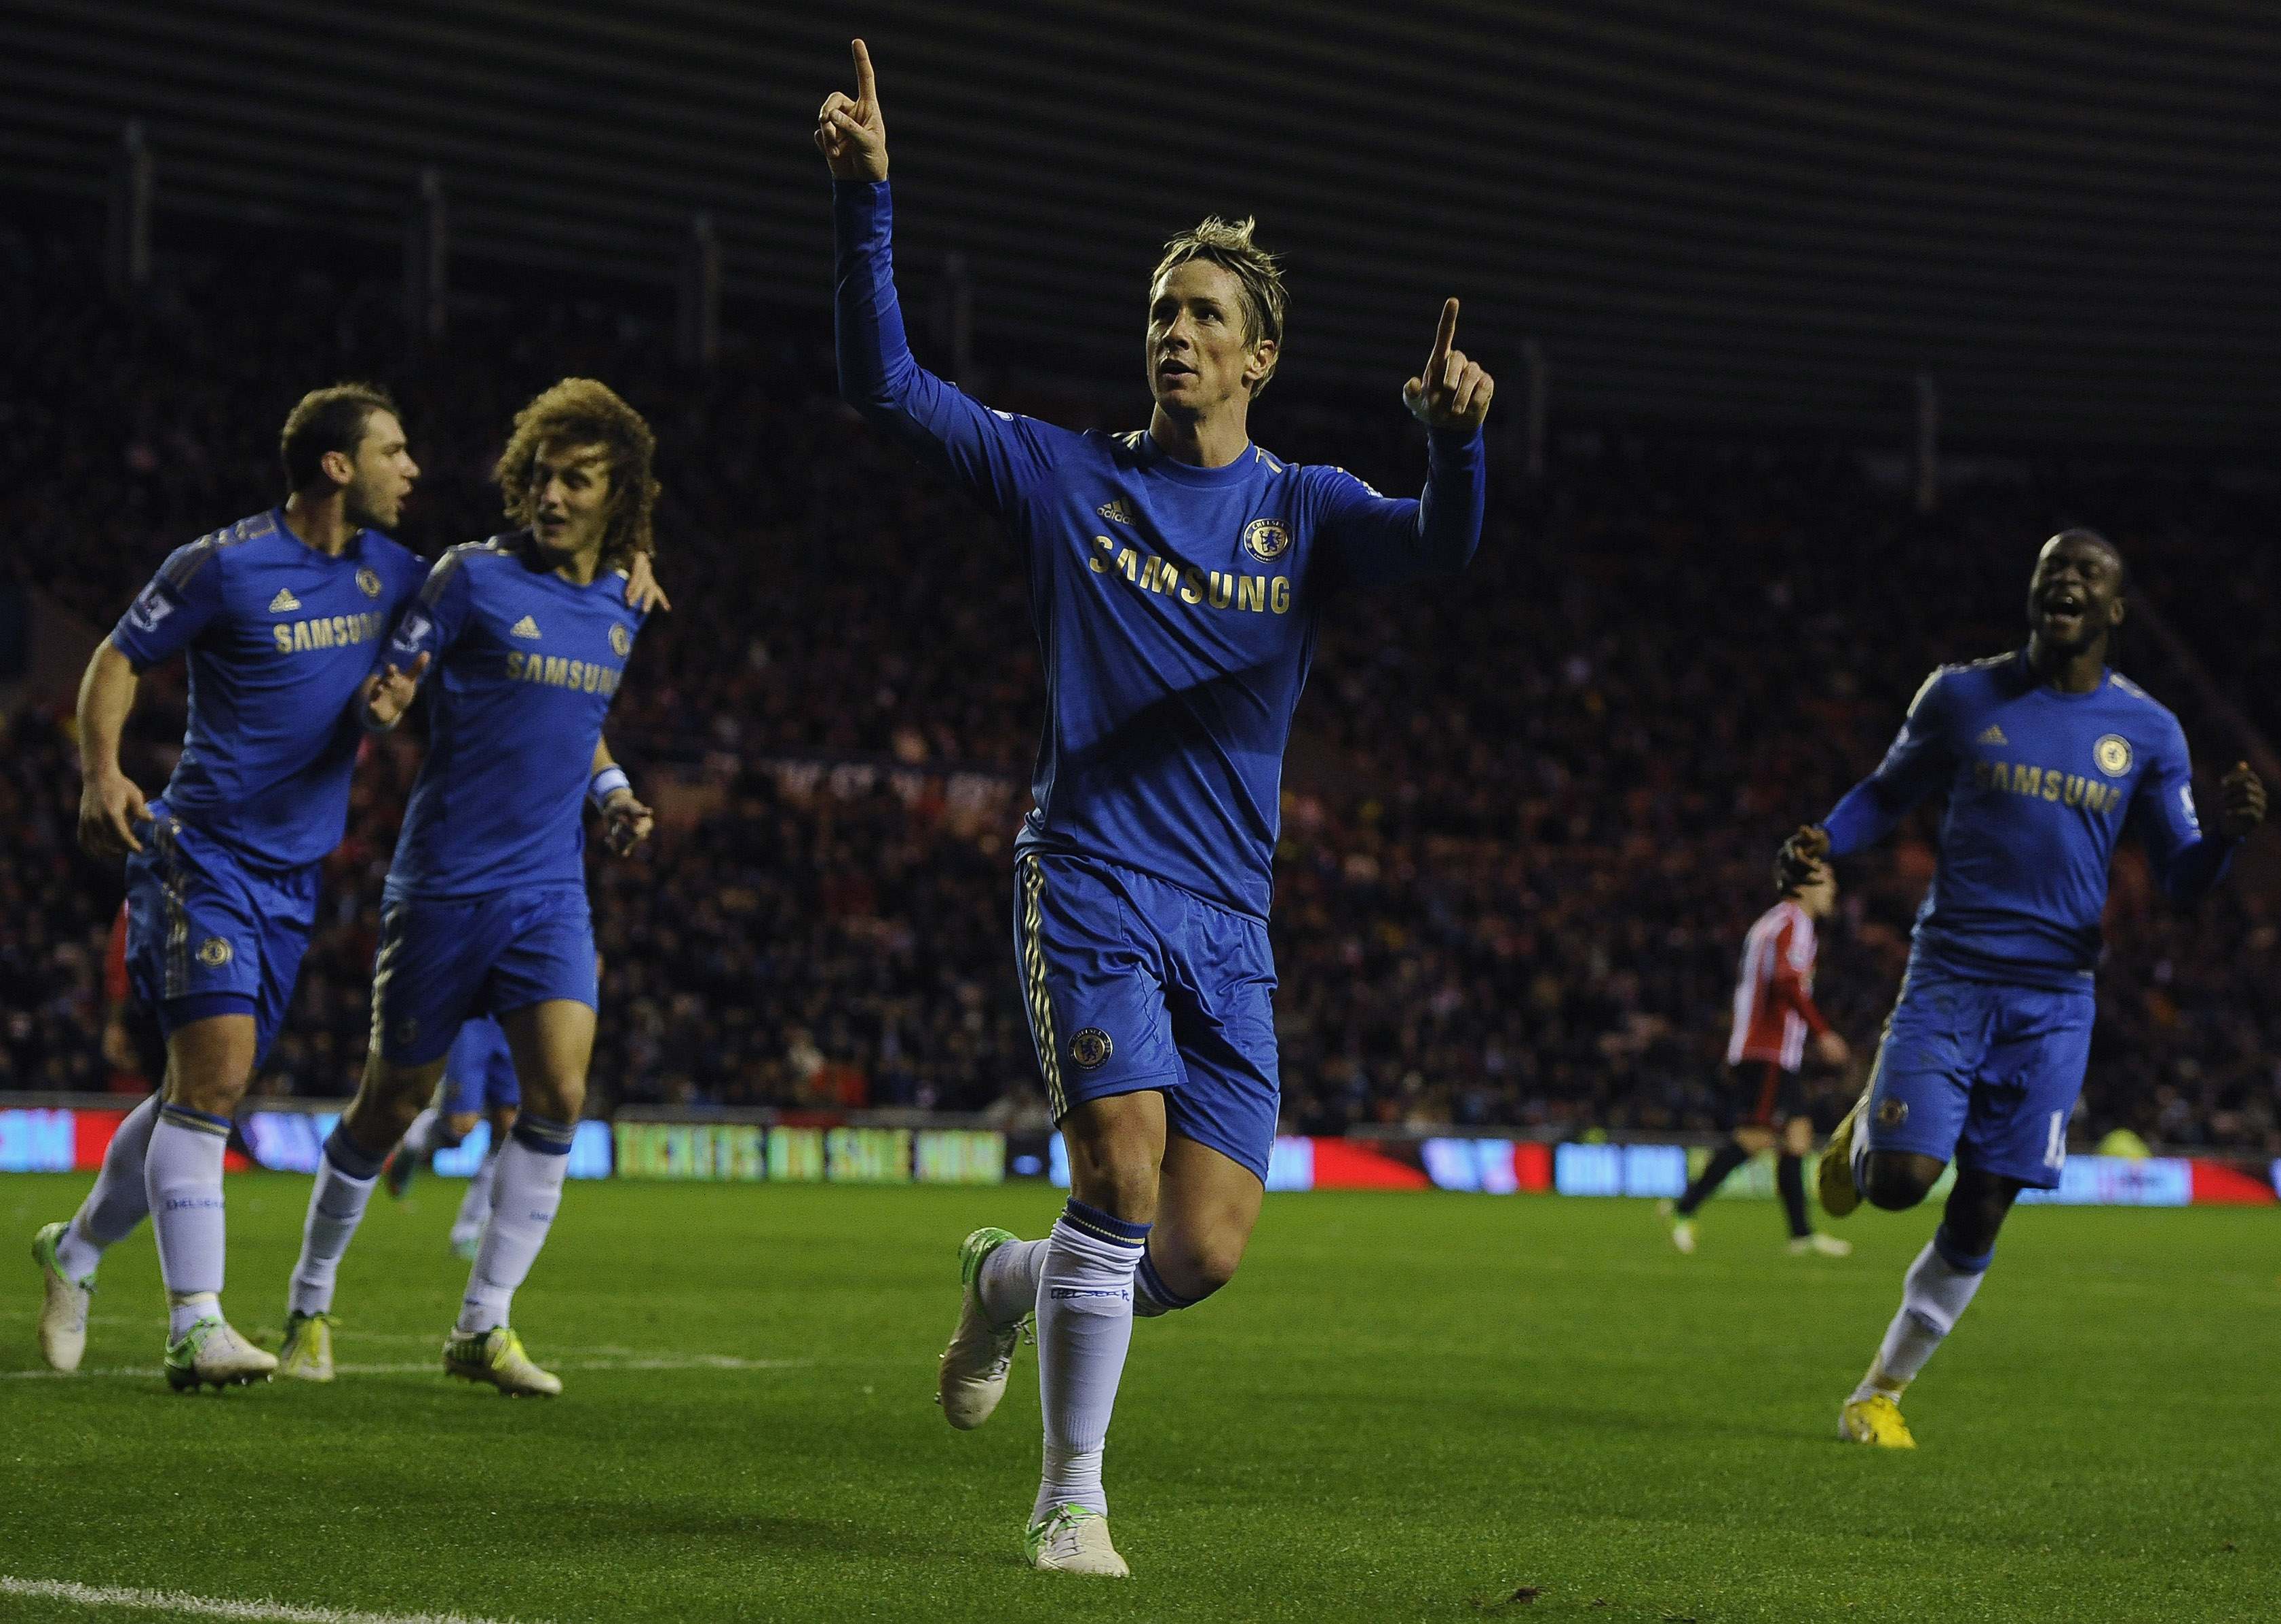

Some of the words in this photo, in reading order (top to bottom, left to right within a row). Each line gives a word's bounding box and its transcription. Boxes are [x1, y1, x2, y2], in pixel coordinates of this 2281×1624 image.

[1096, 507, 1136, 526] adidas
[1089, 535, 1289, 614] SAMSUNG
[273, 612, 382, 654] SAMSUN
[507, 651, 622, 695] SAMSUN
